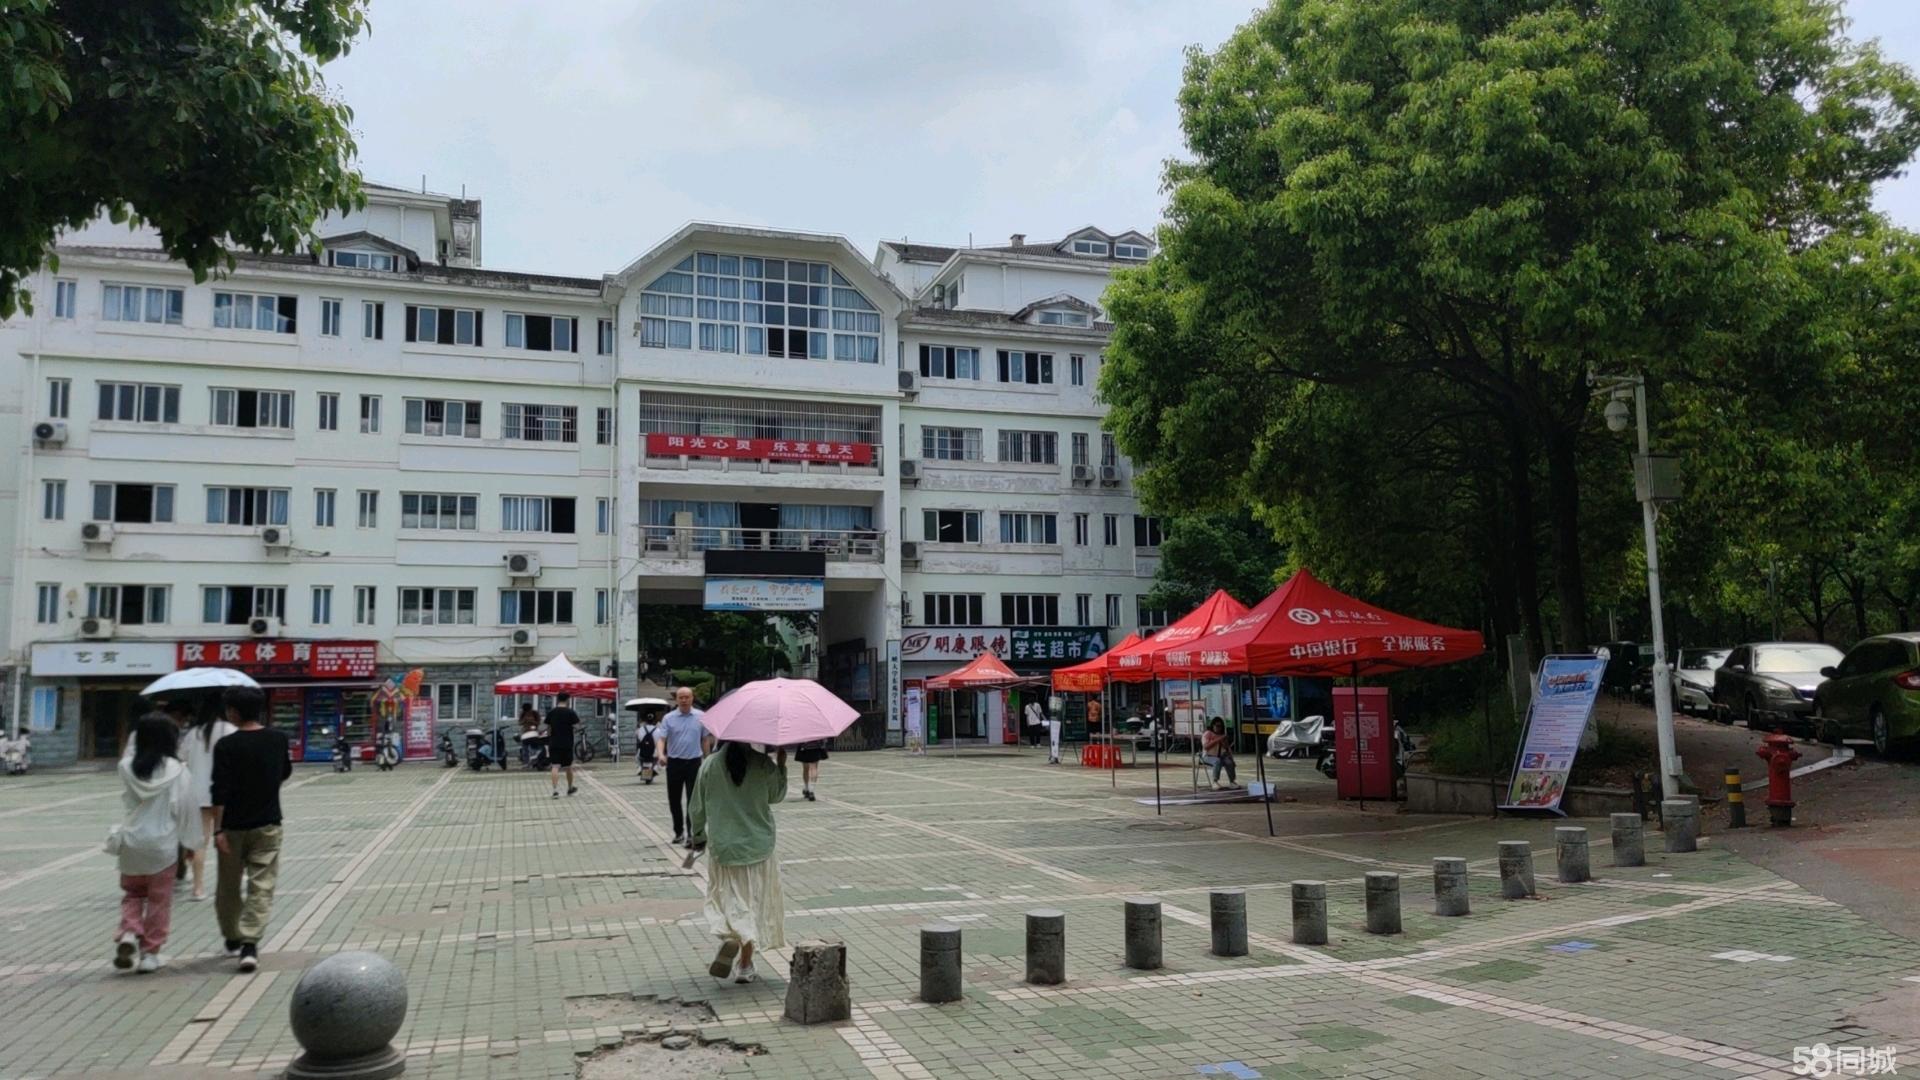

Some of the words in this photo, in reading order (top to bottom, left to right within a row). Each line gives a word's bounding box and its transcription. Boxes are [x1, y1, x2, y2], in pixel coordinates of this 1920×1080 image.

[668, 436, 752, 451] 阳光心灵
[773, 441, 853, 455] 乐享春天
[182, 643, 312, 662] 欣欣体育
[934, 632, 1009, 656] 明康眼镜
[1014, 640, 1082, 659] 学生超市
[1289, 638, 1358, 659] 中国银行
[1381, 635, 1446, 652] 全球服务
